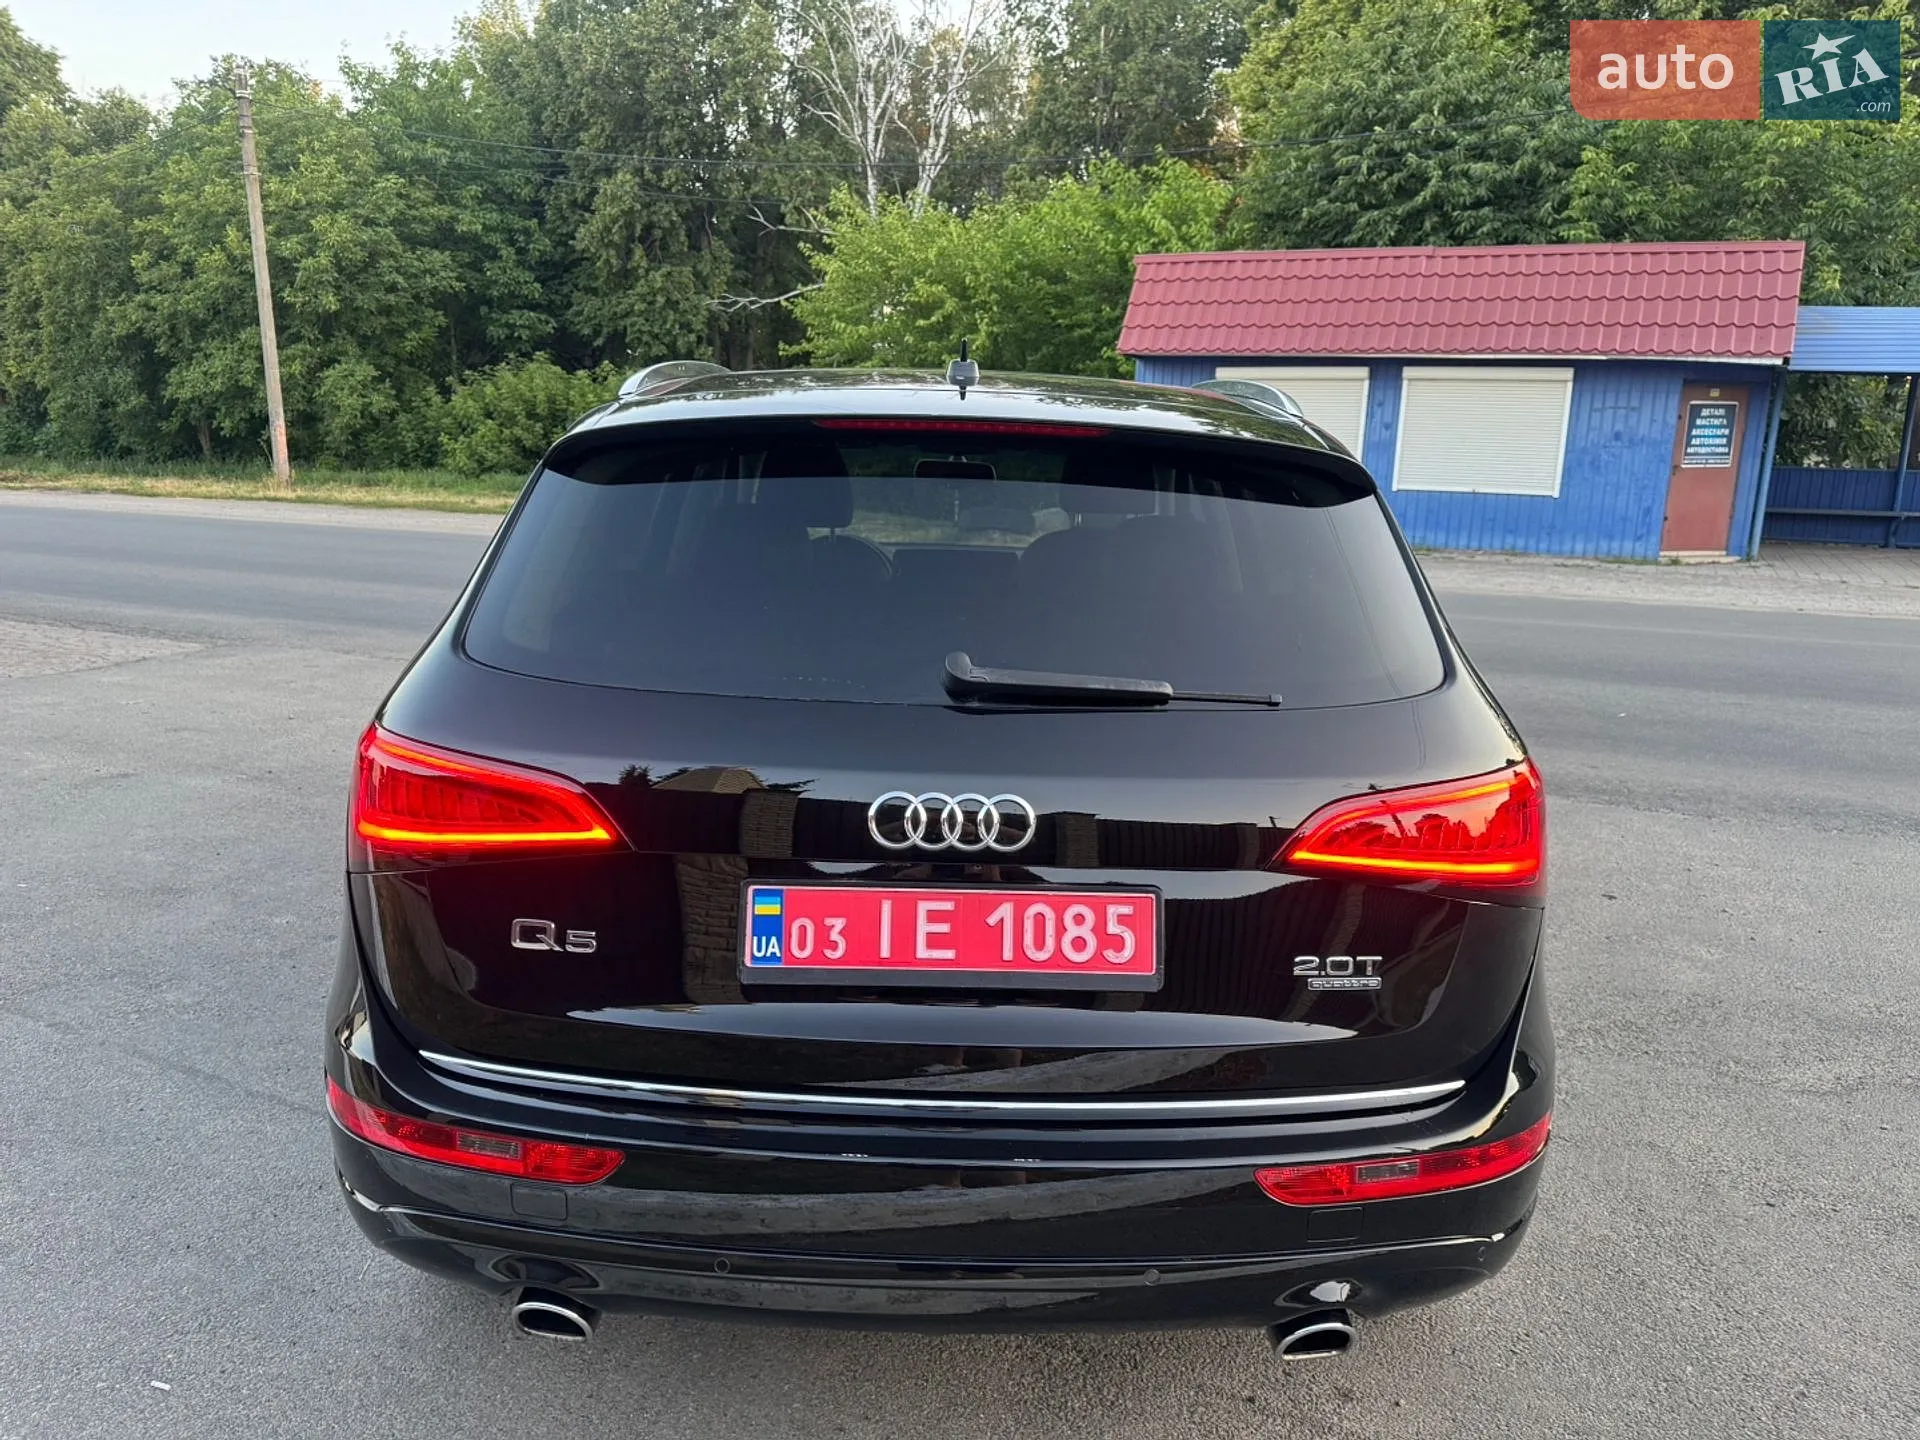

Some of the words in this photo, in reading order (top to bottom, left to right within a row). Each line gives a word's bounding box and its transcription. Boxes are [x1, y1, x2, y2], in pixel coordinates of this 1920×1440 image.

[510, 918, 598, 953] Q5
[789, 917, 847, 960] 03
[878, 899, 956, 960] IE
[984, 901, 1136, 964] 1085
[752, 936, 782, 958] UA
[1293, 955, 1383, 976] 2.0T
[1310, 979, 1380, 989] quattro
